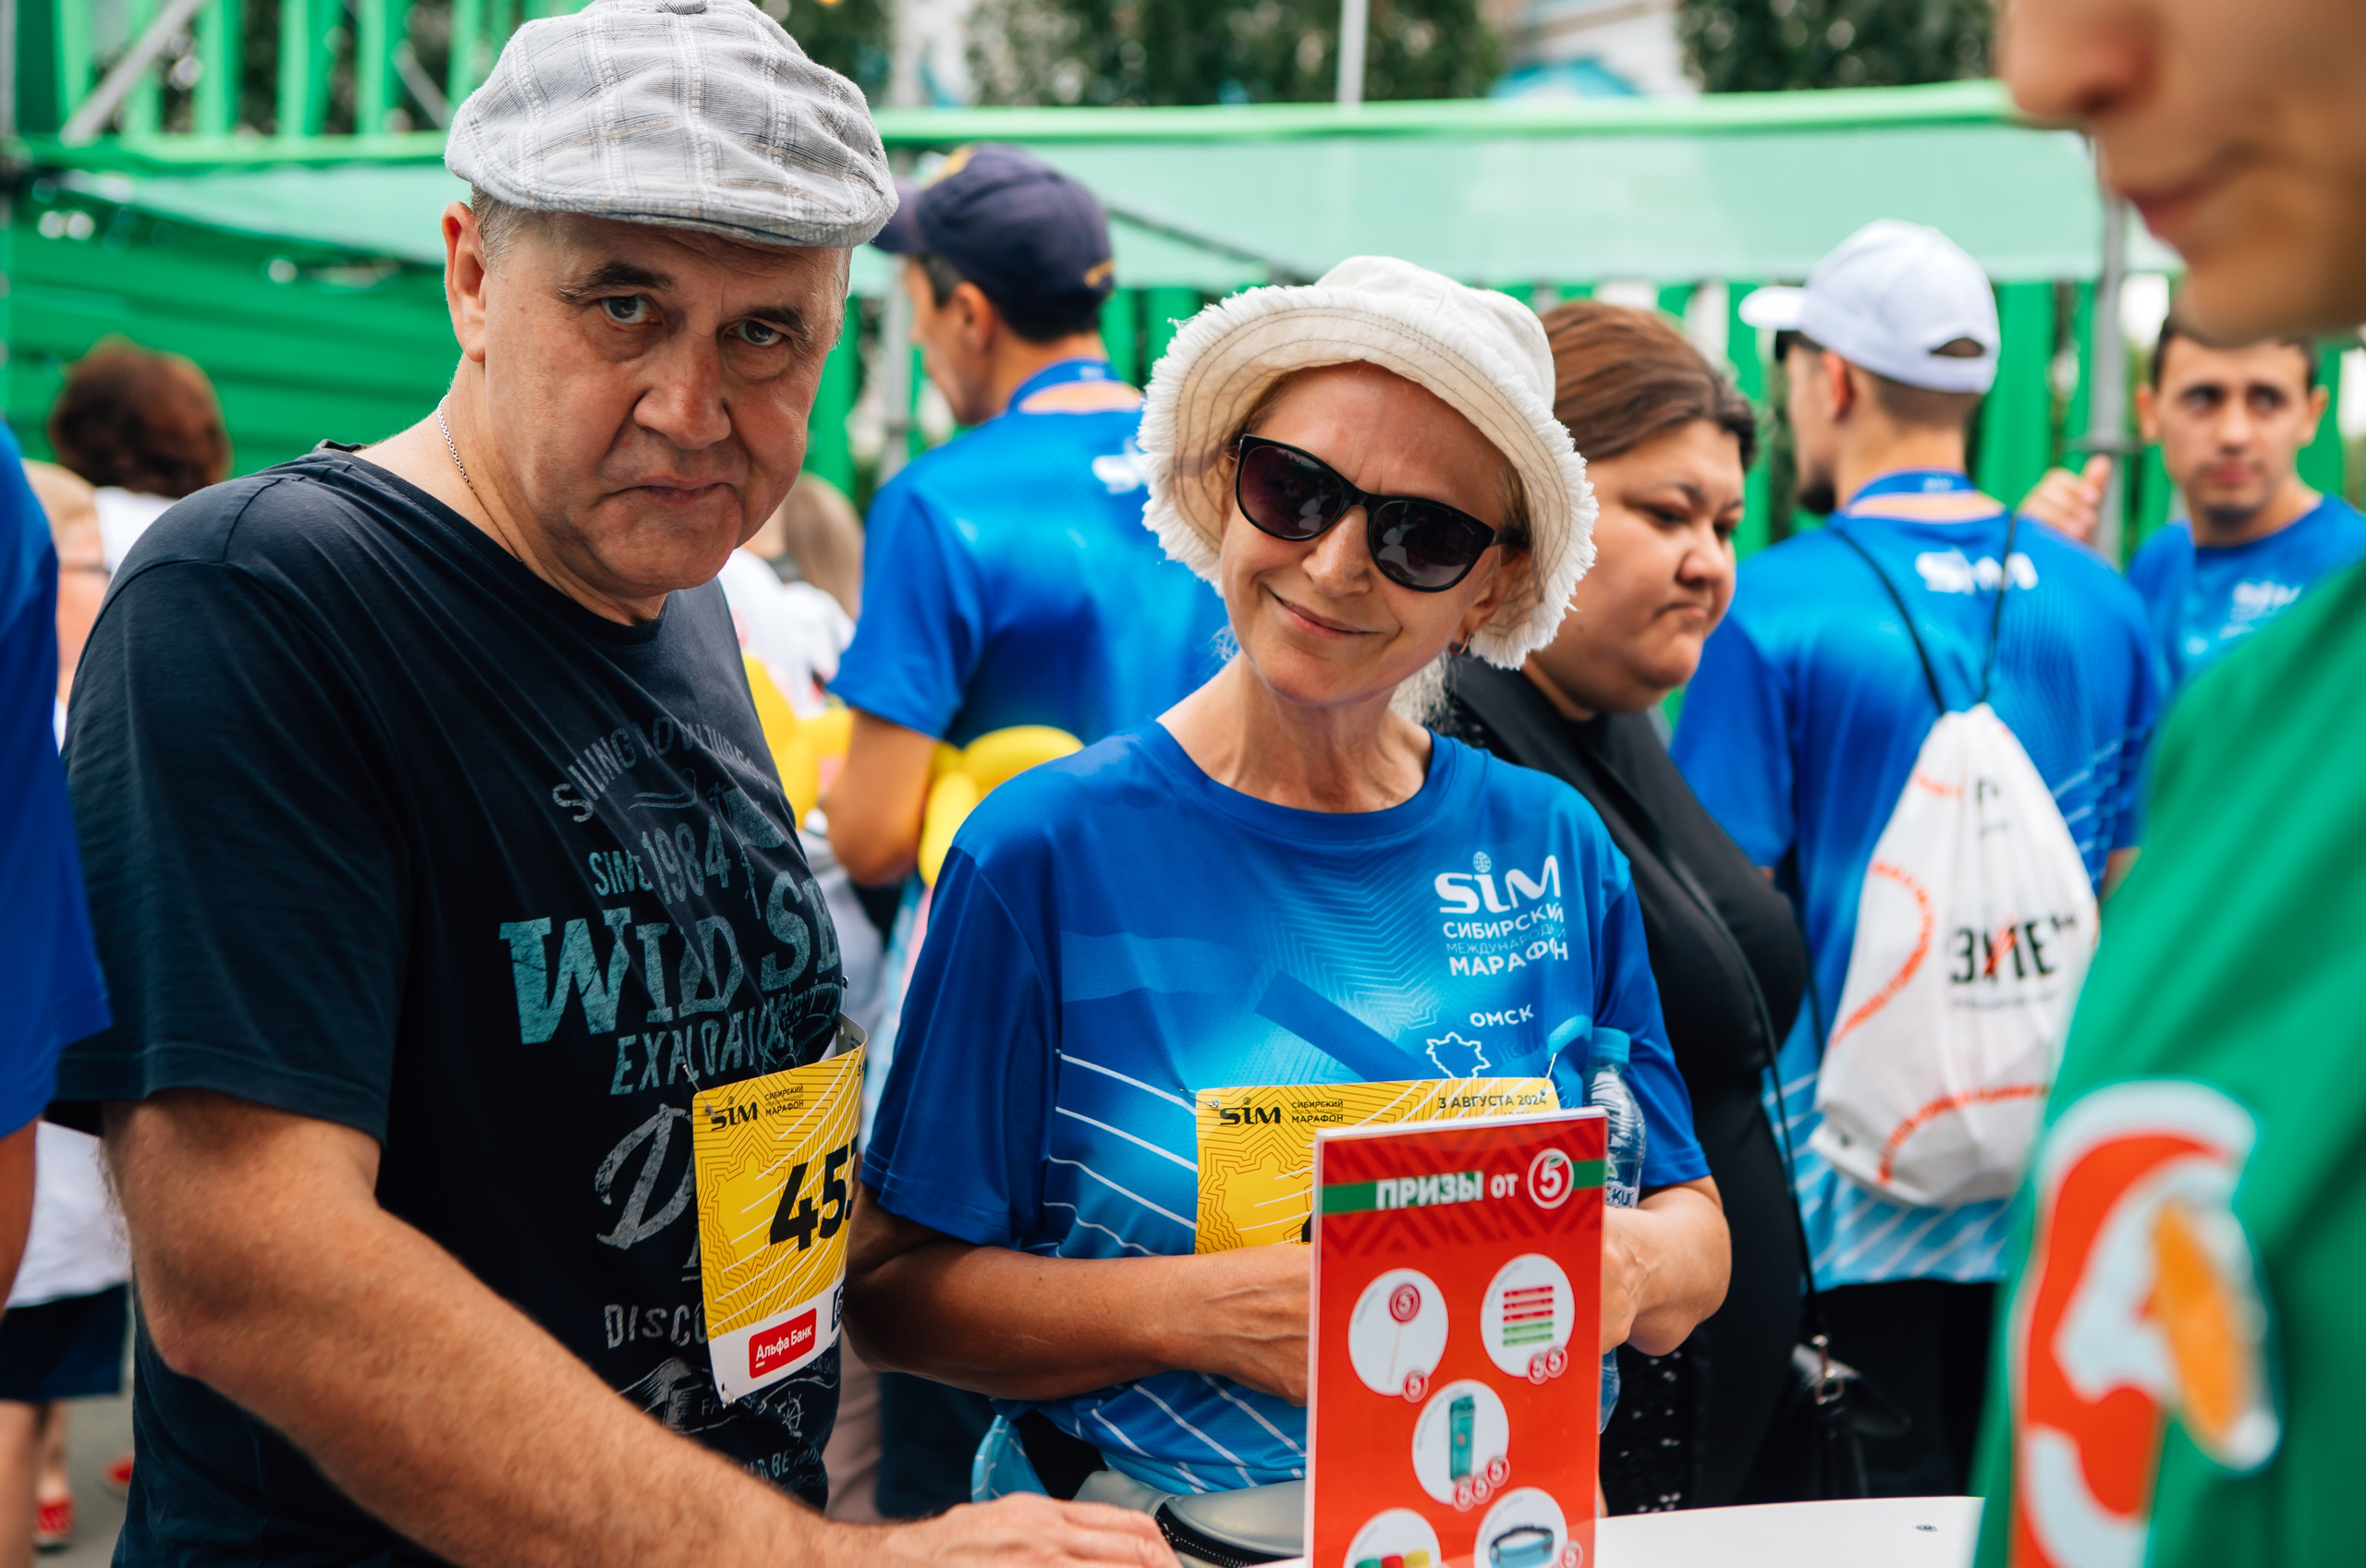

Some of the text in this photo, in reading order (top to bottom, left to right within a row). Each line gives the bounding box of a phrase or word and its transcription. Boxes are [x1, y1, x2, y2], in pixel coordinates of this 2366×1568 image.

[641, 815, 731, 906] 1984
[1443, 902, 1565, 940] СИБИРСКИЙ
[1470, 1004, 1534, 1027] ОМСК
[764, 1084, 803, 1101] СИБИРСКИЙ
[1438, 1093, 1547, 1109] 3 АВГУСТА 2024
[765, 1100, 804, 1117] МАРАФОН
[1291, 1099, 1344, 1110] СИБИРСКИЙ
[1291, 1114, 1344, 1124] МАРАФОН
[1376, 1170, 1483, 1210] ПРИЗЫ
[755, 1324, 812, 1364] Альфа Банк
